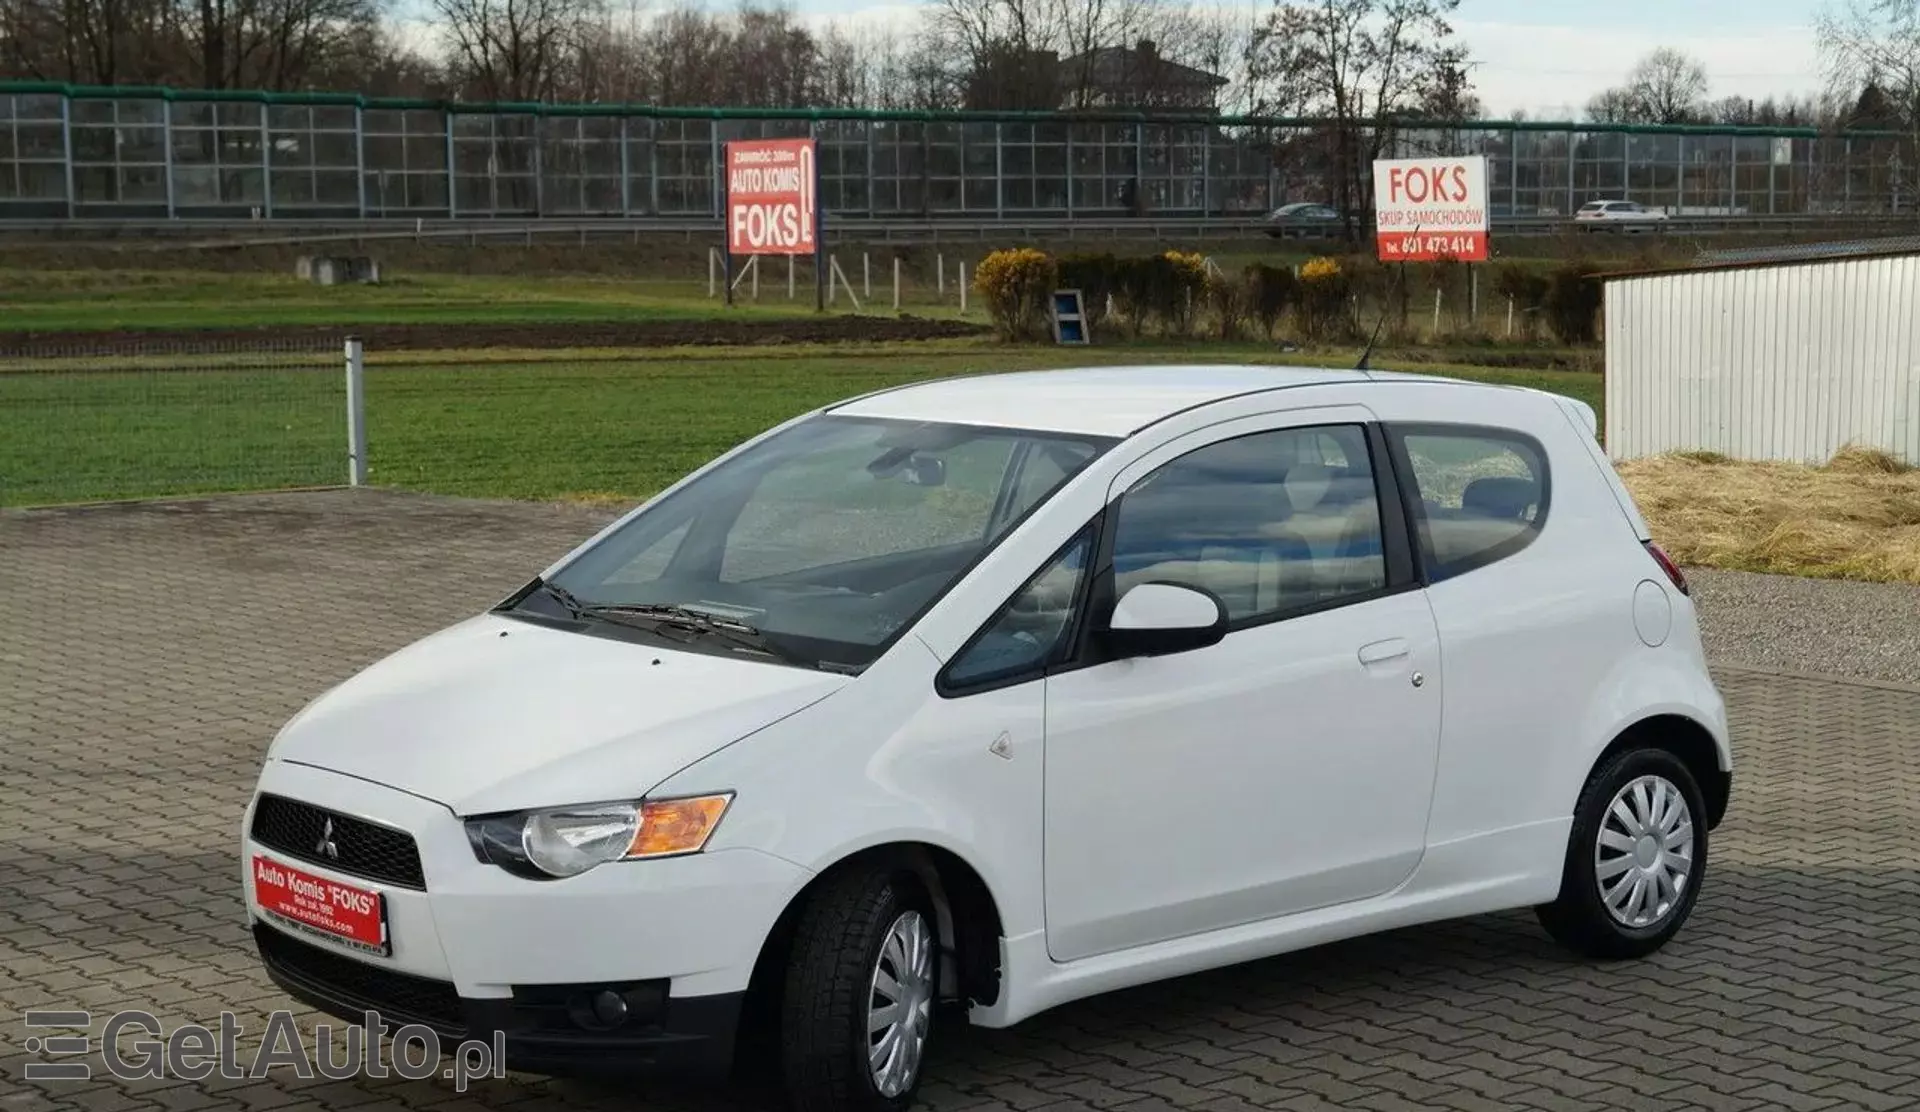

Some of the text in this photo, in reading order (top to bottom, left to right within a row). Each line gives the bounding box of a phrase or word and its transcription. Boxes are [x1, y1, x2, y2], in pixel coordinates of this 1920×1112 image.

[731, 166, 800, 193] AUTO KOMIS
[1389, 165, 1468, 203] FOKS
[733, 203, 798, 247] FOKS
[1379, 206, 1483, 225] SKUP SAMOCHODÓW
[1402, 236, 1422, 253] 601
[1426, 236, 1449, 253] 473
[1451, 235, 1475, 253] 414
[258, 861, 286, 888] Auto
[286, 871, 327, 902] Komis
